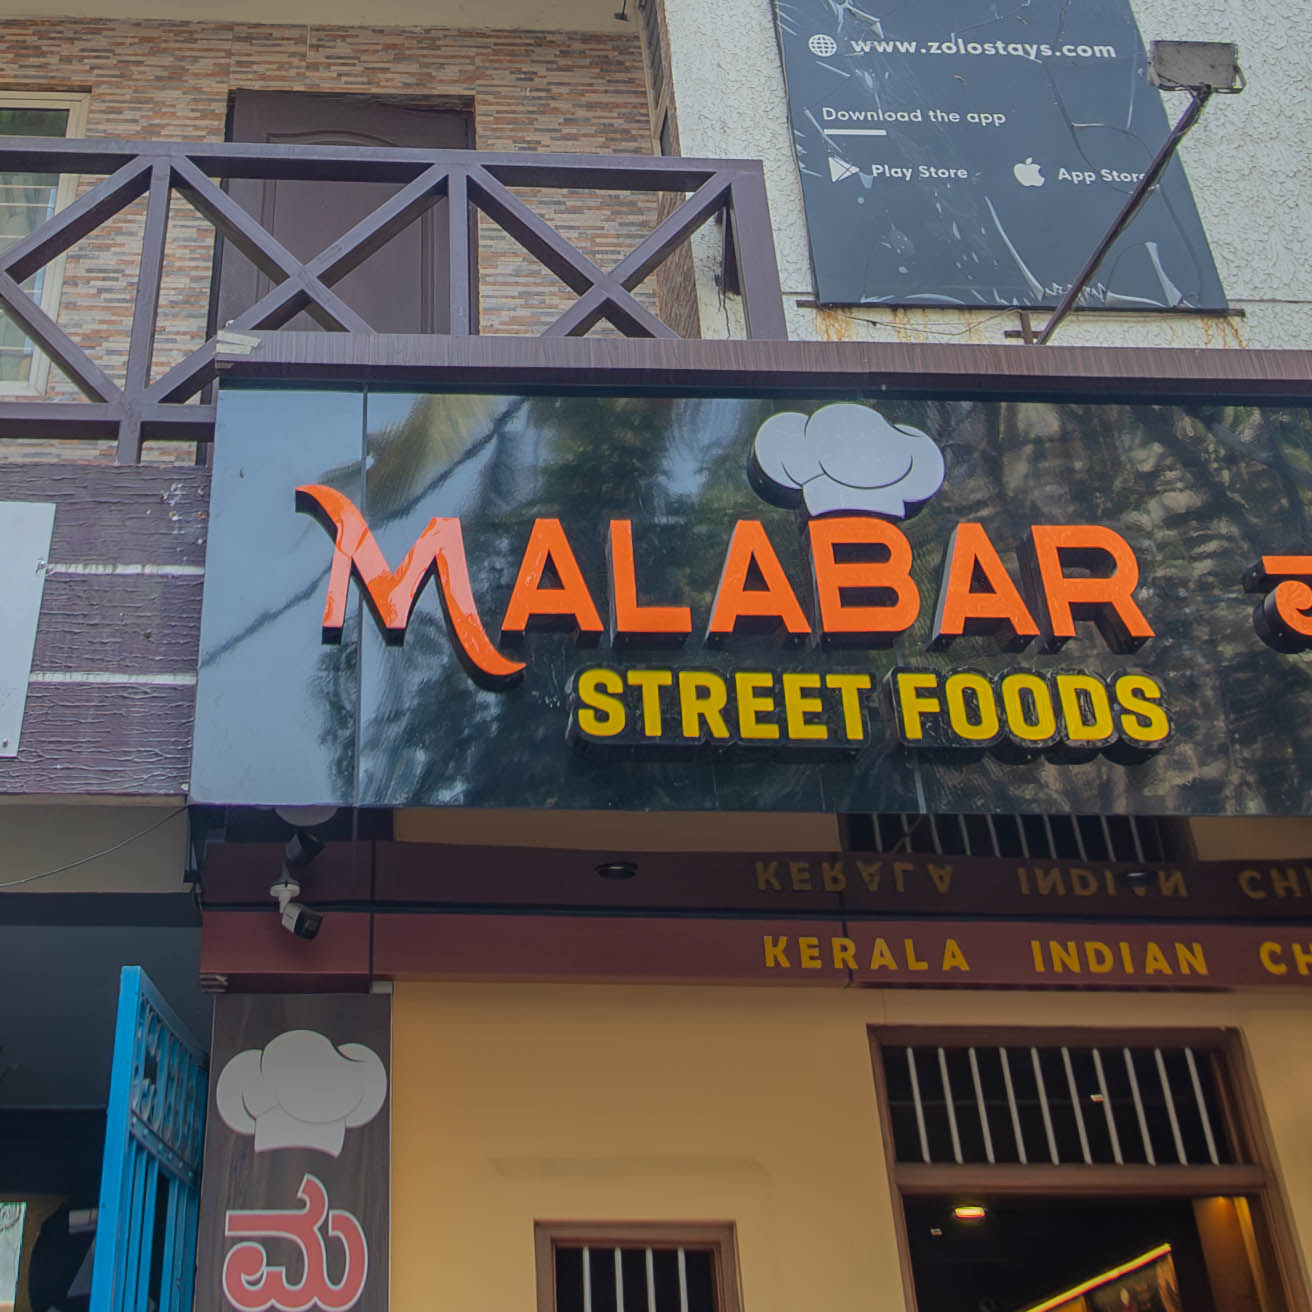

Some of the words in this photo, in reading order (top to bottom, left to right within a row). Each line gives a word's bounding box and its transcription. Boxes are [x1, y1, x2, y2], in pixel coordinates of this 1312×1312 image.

[850, 38, 1117, 59] www.zolostays.com
[822, 106, 922, 124] Download
[928, 108, 960, 124] the
[966, 110, 1006, 126] app
[871, 164, 913, 182] Play
[918, 164, 968, 180] Store
[1057, 168, 1096, 184] App
[295, 485, 1155, 677] MALABAR
[578, 668, 871, 741] STREET
[896, 672, 1170, 742] FOODS
[763, 935, 970, 972] KERALA
[1030, 940, 1209, 976] INDIAN
